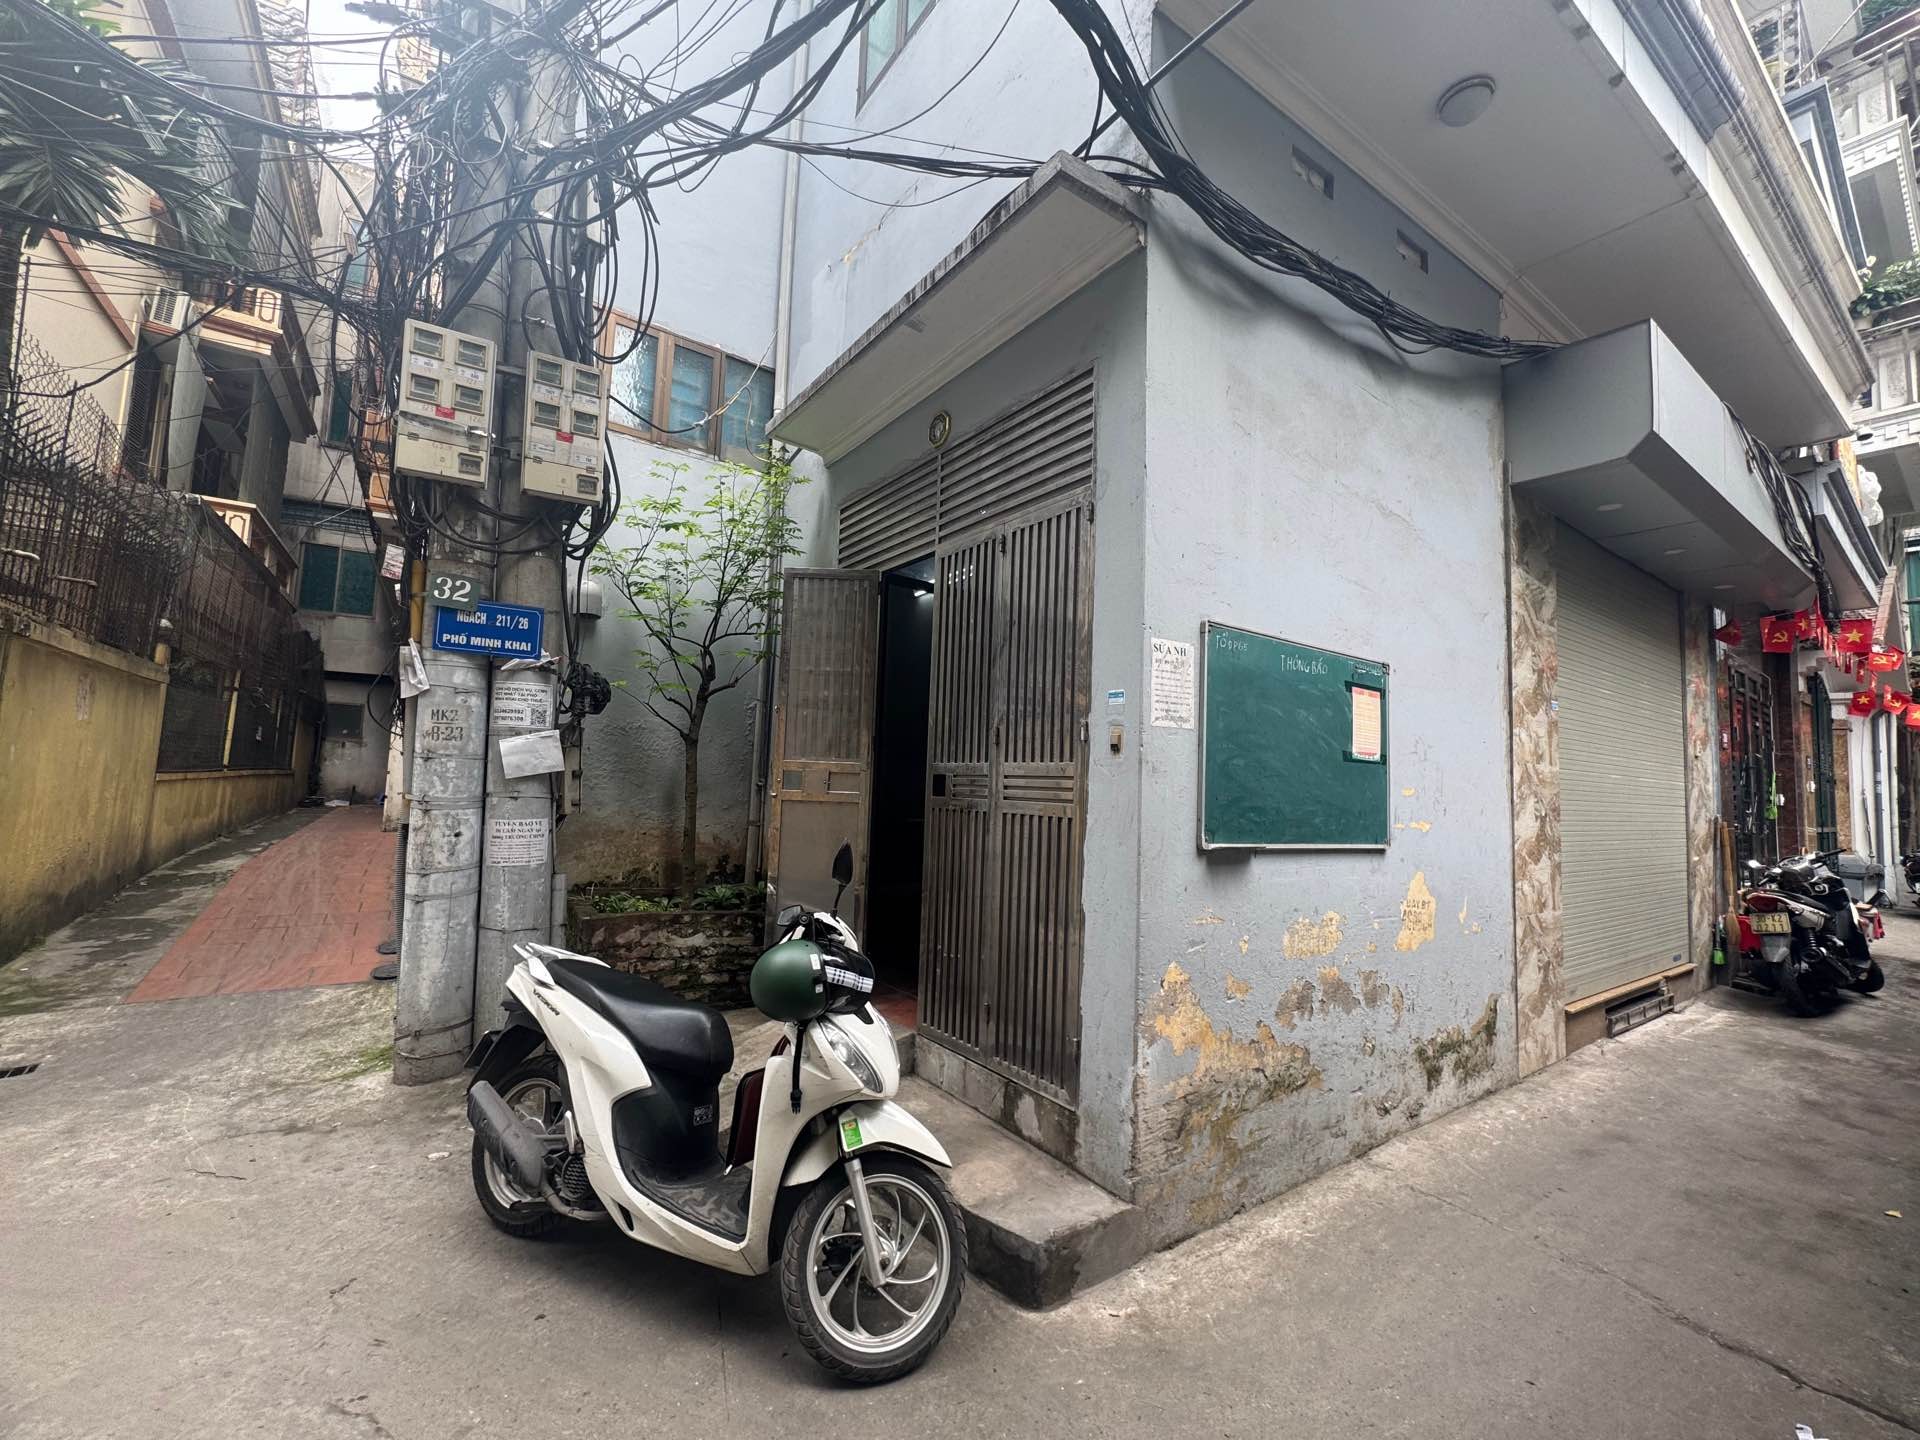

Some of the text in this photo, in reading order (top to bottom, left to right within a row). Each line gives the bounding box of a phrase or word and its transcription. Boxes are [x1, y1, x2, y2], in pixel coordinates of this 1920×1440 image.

[433, 576, 472, 602] 32
[495, 614, 529, 630] 211/26
[470, 636, 502, 648] MINH
[504, 640, 532, 652] KHAI
[1280, 653, 1329, 675] THÔNG BÁO
[431, 708, 459, 721] MK2
